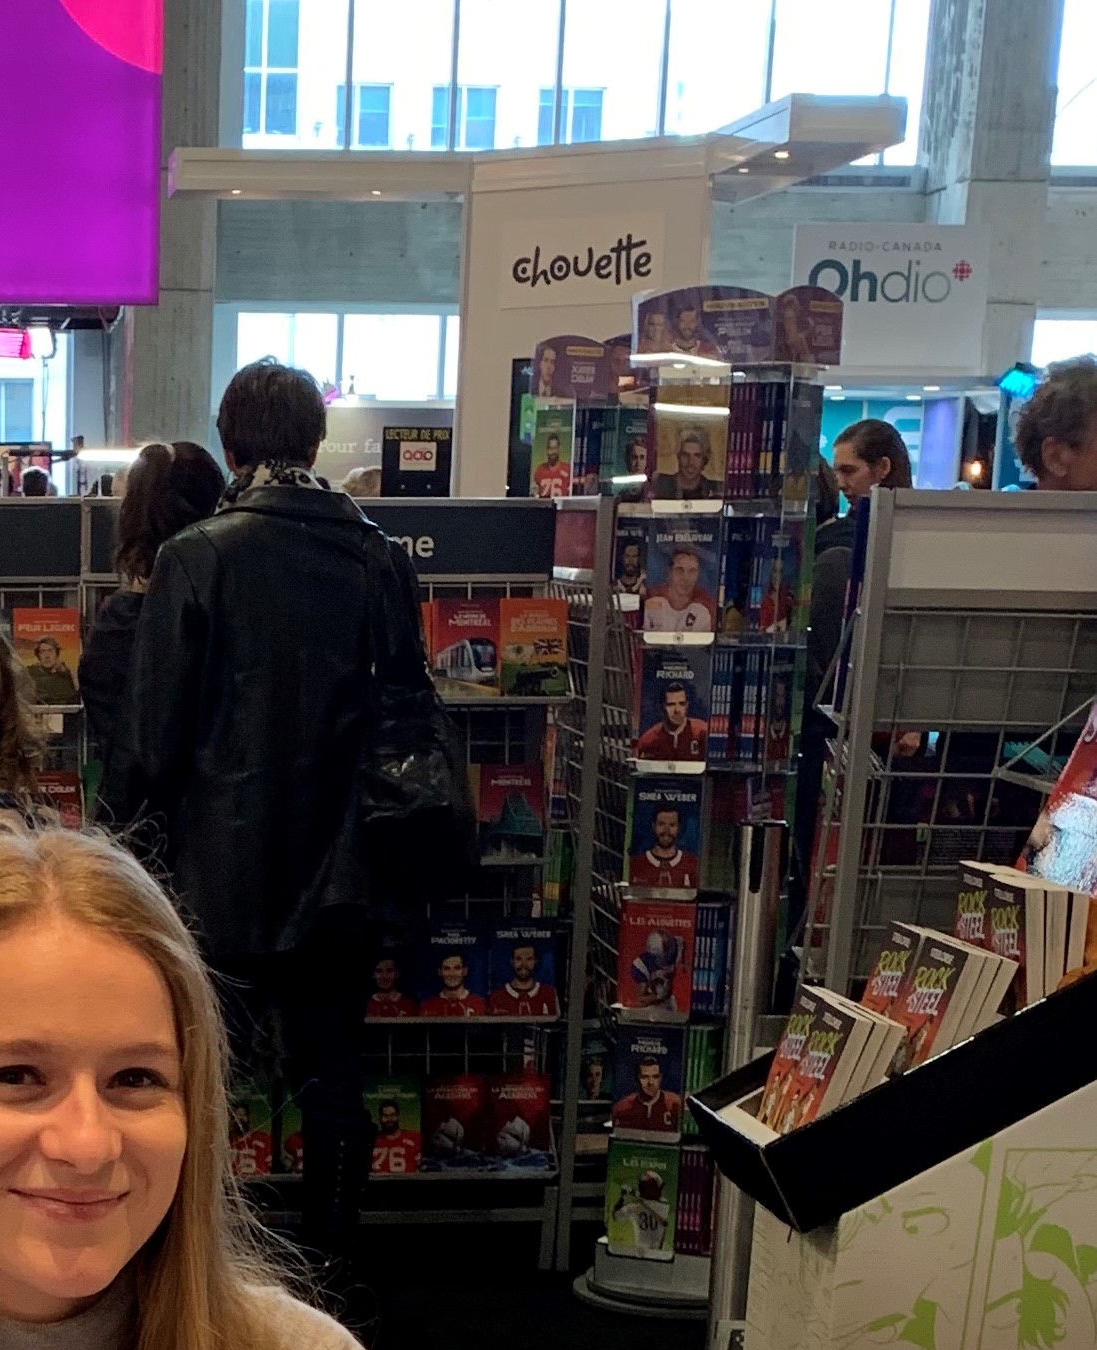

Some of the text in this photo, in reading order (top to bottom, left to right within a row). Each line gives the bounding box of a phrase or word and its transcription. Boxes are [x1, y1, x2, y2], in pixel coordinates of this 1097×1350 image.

[829, 241, 942, 253] RADIO-CANADA
[512, 234, 651, 286] chouette
[656, 670, 694, 680] RICHARD
[639, 792, 697, 802] SHEA WEBER
[877, 950, 911, 973] ROCK
[914, 967, 955, 990] ROCK
[808, 1030, 844, 1055] ROCK
[371, 1147, 407, 1172] 76
